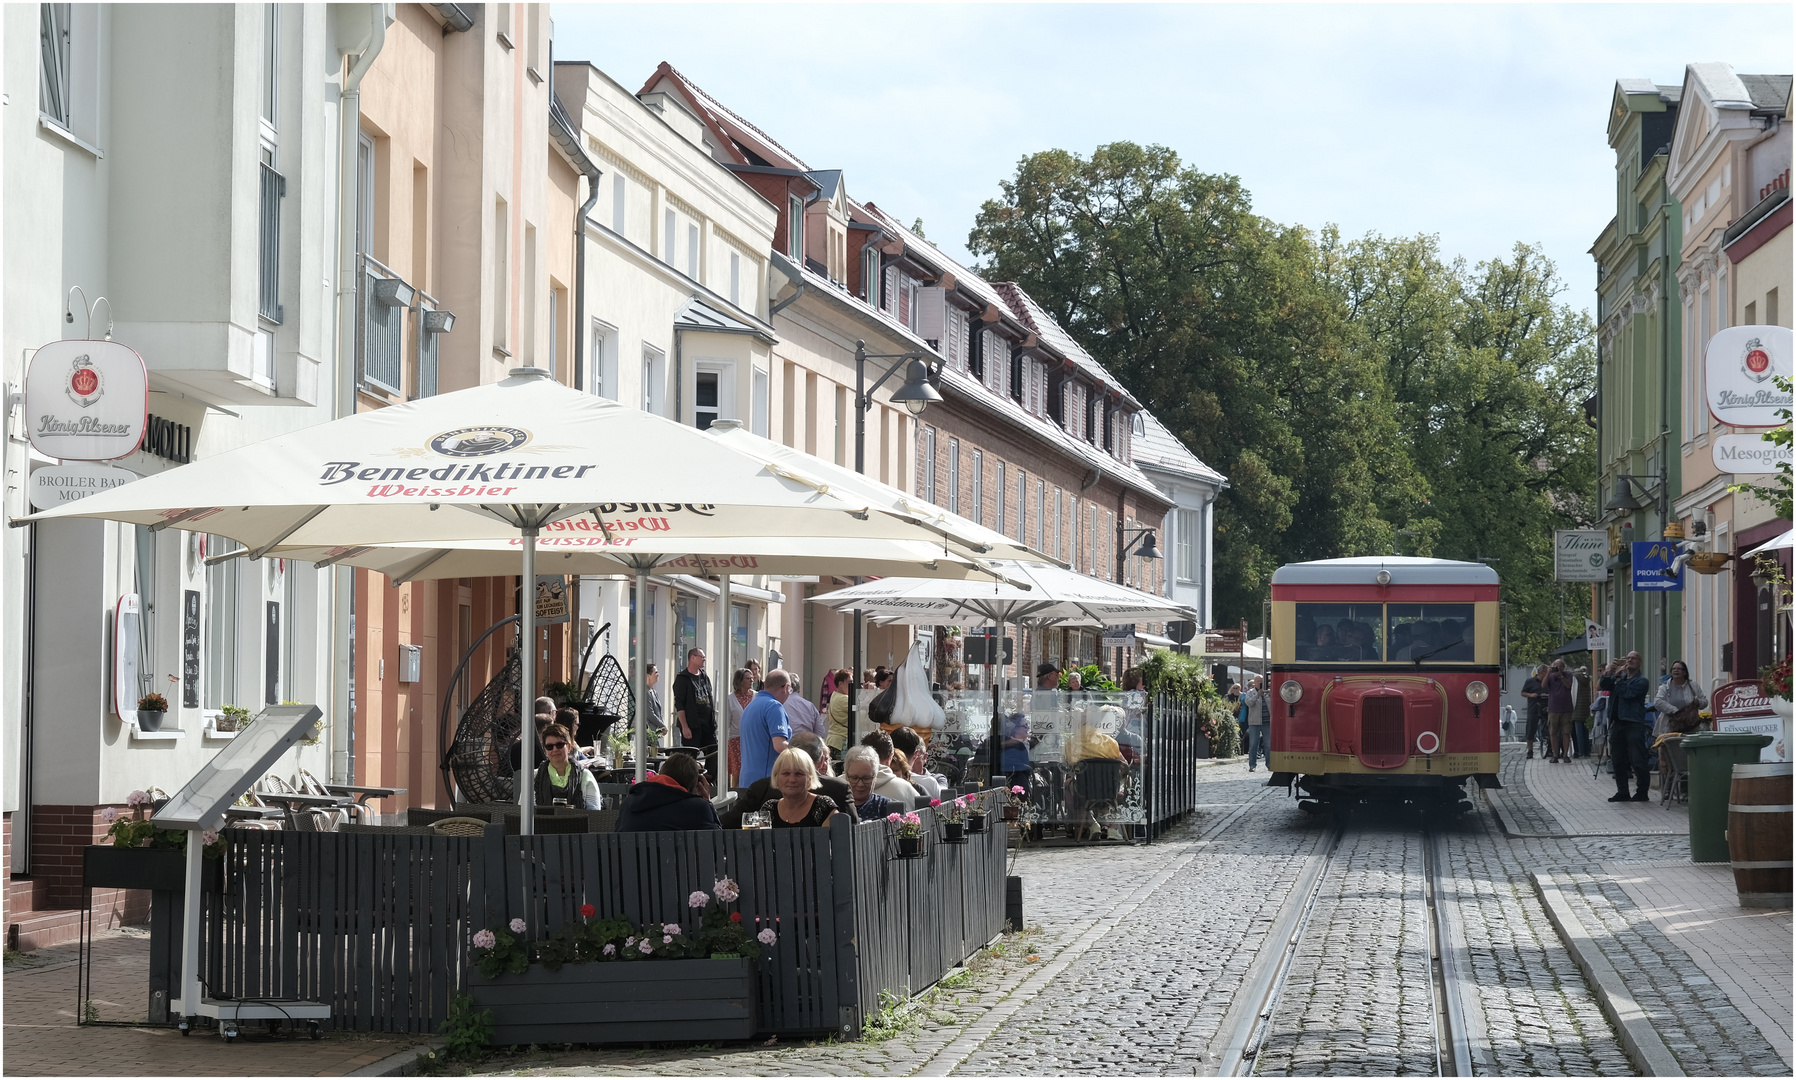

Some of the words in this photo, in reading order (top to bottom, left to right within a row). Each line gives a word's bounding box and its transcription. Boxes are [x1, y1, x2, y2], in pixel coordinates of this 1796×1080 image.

[1717, 389, 1756, 408] König
[1753, 389, 1793, 405] Pilsene
[37, 414, 80, 436] König
[78, 415, 131, 435] Pilsener
[147, 413, 191, 464] MOLLI
[436, 427, 526, 442] BENEDIKTINER
[1720, 445, 1793, 466] Mesogios
[319, 459, 597, 486] Benediktiner
[39, 476, 97, 488] BROILER
[100, 478, 126, 488] BAR
[366, 484, 518, 498] Weissbier
[1558, 534, 1605, 551] Thüne
[1721, 694, 1772, 708] Braun
